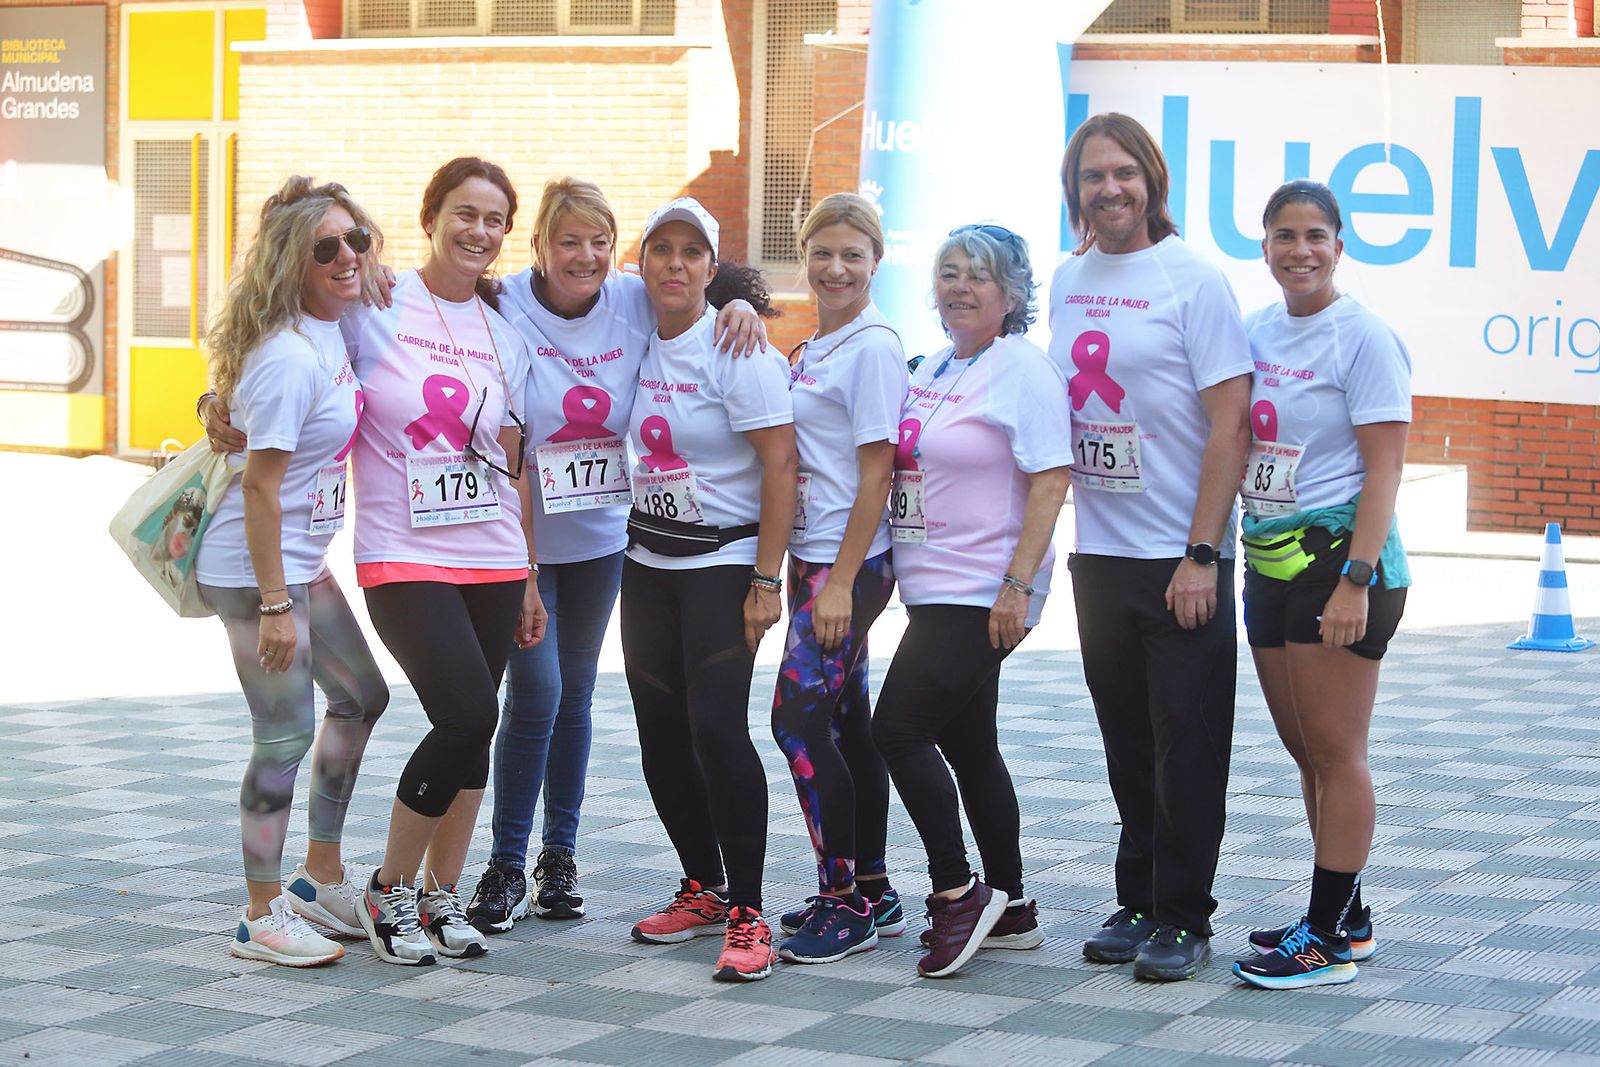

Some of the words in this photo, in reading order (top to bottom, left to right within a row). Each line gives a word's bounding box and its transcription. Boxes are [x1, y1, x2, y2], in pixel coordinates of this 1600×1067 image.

[2, 39, 66, 52] BIBLIOTECA
[2, 51, 61, 63] MUNICIPAL
[2, 70, 95, 93] Almudena
[1, 97, 80, 119] Grandes
[1065, 295, 1095, 305] CARRERA
[1096, 296, 1107, 306] DE
[1108, 296, 1119, 306] LA
[1121, 298, 1150, 310] MUJER
[1085, 308, 1110, 318] HUELVA
[397, 333, 437, 351] CARRERA
[439, 343, 451, 354] DE
[453, 346, 464, 357] LA
[467, 349, 494, 362] MUJER
[430, 353, 459, 367] HUELVA
[572, 358, 585, 367] DE
[587, 356, 599, 367] LA
[600, 347, 624, 364] MUJER
[676, 383, 699, 393] MUJER
[1109, 426, 1135, 434] MUJER
[583, 442, 592, 451] DE
[593, 442, 602, 450] LA
[603, 440, 623, 449] MUJER
[453, 455, 462, 463] DE
[1078, 439, 1116, 470] 175
[565, 459, 609, 488] 177
[666, 471, 690, 483] MUJER
[1255, 463, 1275, 492] 83
[435, 471, 478, 502] 179
[644, 492, 679, 519] 188
